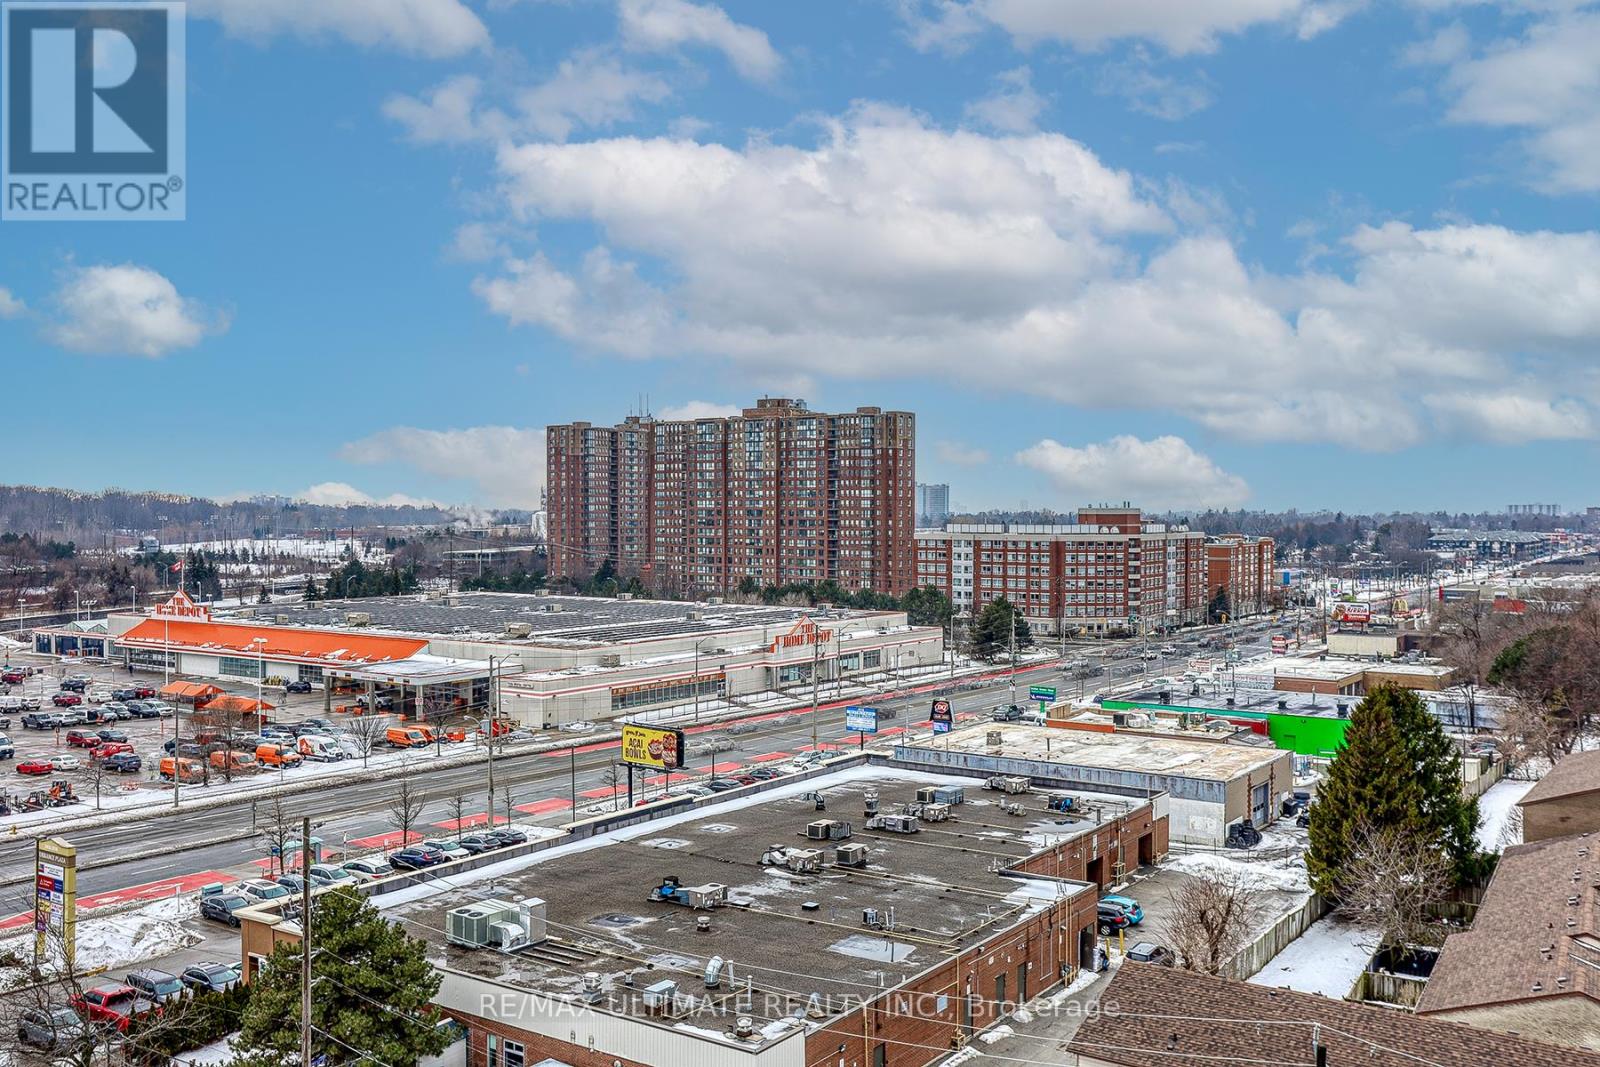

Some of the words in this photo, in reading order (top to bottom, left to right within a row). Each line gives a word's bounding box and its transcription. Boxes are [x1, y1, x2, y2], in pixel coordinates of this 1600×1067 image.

[172, 597, 185, 606] THE
[177, 606, 201, 618] DEPOT
[801, 624, 813, 633] THE
[783, 634, 803, 648] HOME
[625, 747, 647, 760] BOWLS
